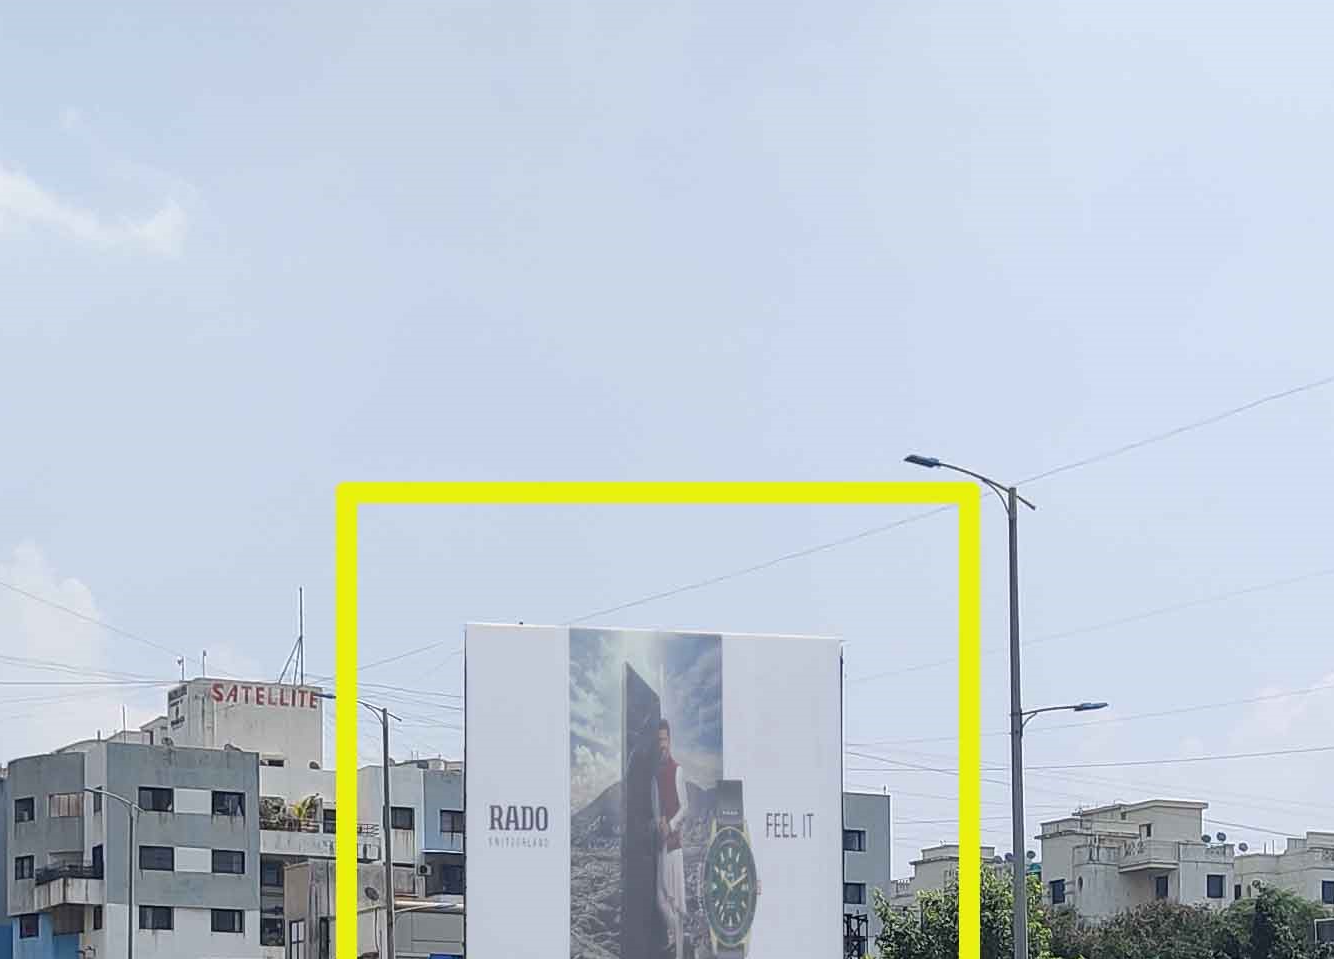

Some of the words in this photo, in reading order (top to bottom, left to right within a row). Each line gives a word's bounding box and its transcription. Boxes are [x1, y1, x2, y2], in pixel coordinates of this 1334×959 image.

[210, 682, 317, 709] SATELLITE
[489, 805, 549, 831] RADO
[766, 813, 797, 838] FEEL
[803, 813, 814, 838] IT
